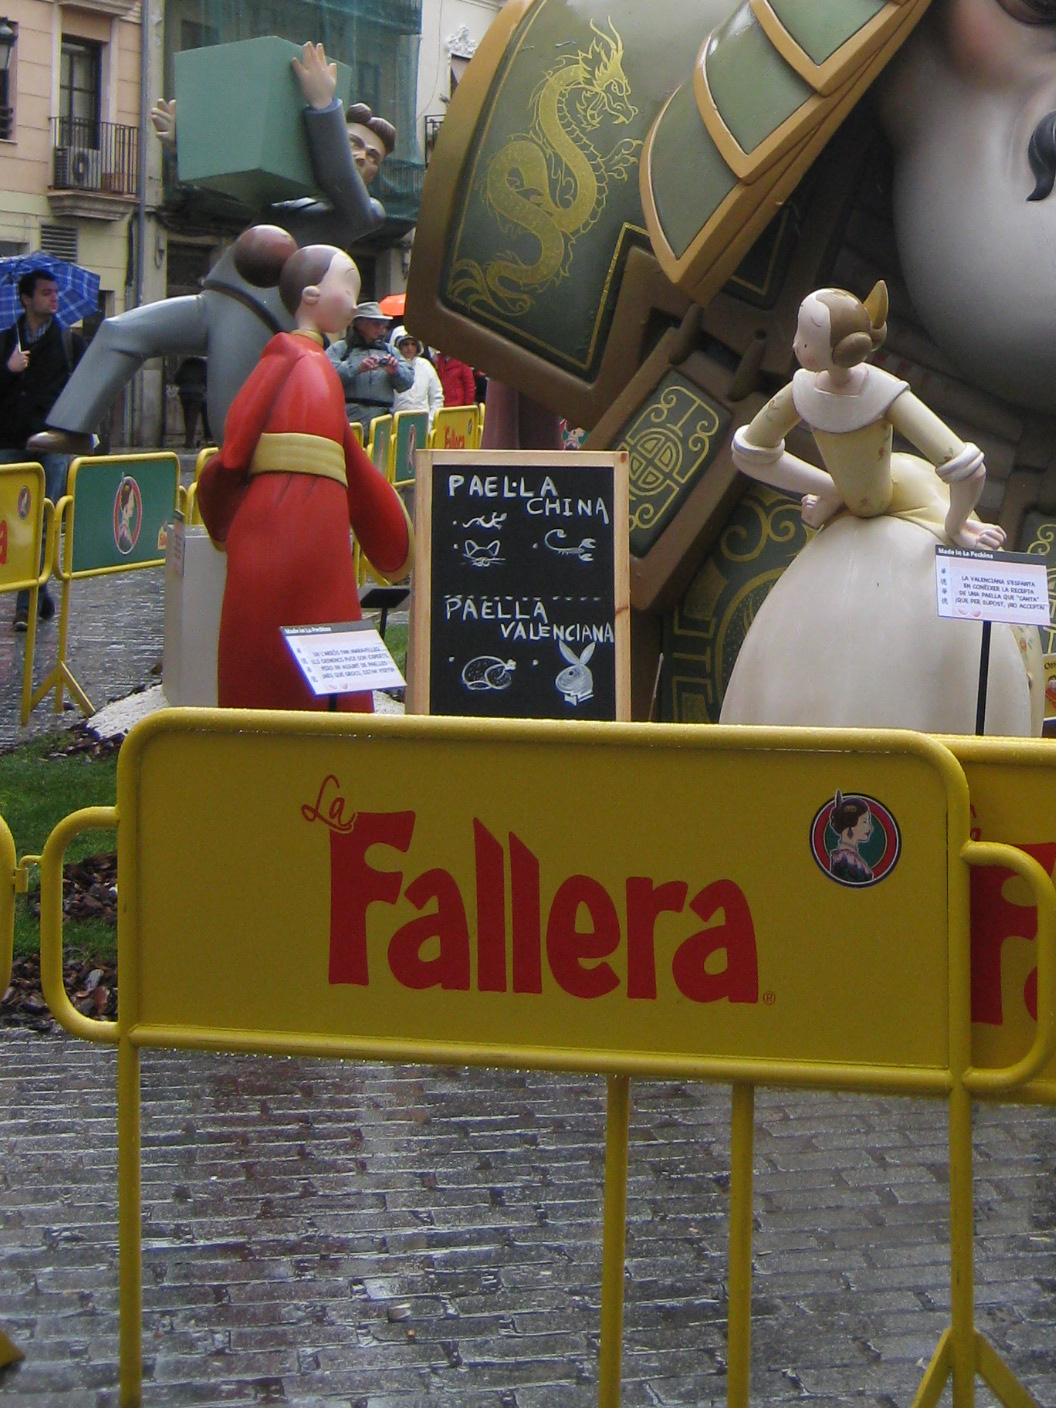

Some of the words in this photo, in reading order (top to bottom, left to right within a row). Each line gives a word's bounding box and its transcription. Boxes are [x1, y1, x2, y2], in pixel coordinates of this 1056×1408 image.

[527, 497, 609, 525] CHINA
[970, 576, 1005, 584] VALENCIANA
[446, 597, 549, 623] PAELLA
[500, 621, 614, 644] VALENCIANA
[301, 775, 356, 831] La
[328, 810, 760, 1004] Fallera
